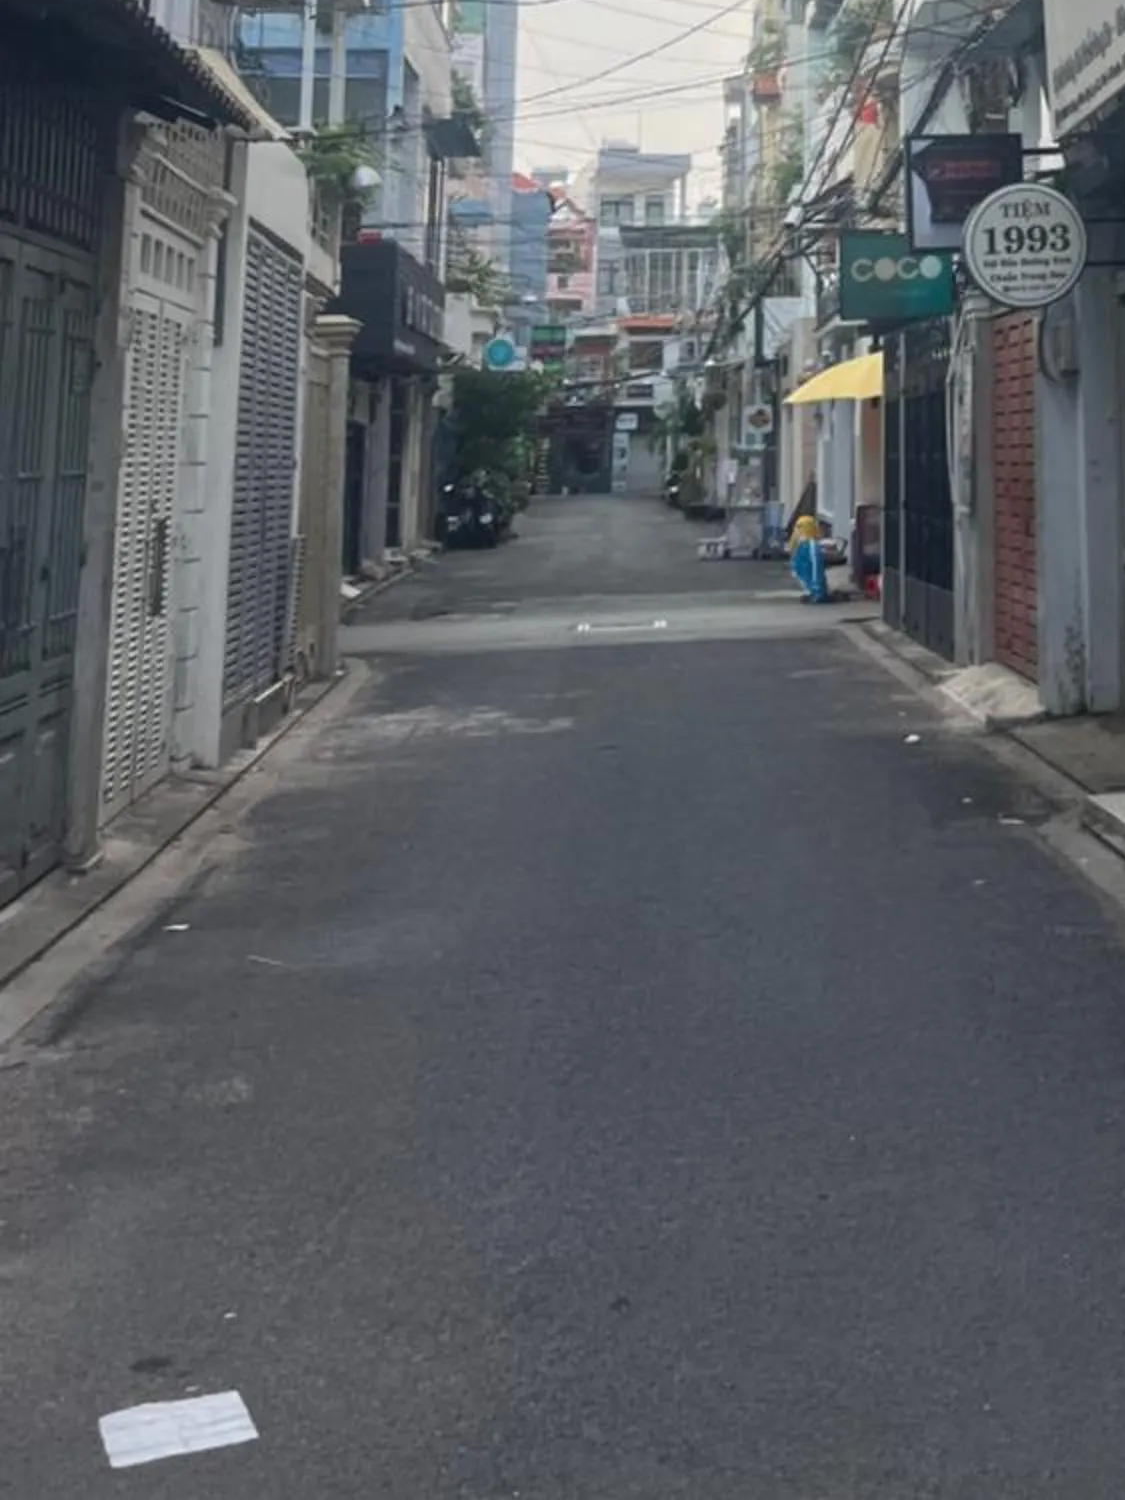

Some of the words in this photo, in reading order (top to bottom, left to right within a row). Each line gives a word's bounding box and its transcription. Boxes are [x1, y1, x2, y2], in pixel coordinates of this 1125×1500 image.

[1001, 198, 1050, 224] TIỆM
[981, 223, 1071, 256] 1993
[850, 254, 944, 284] COCO
